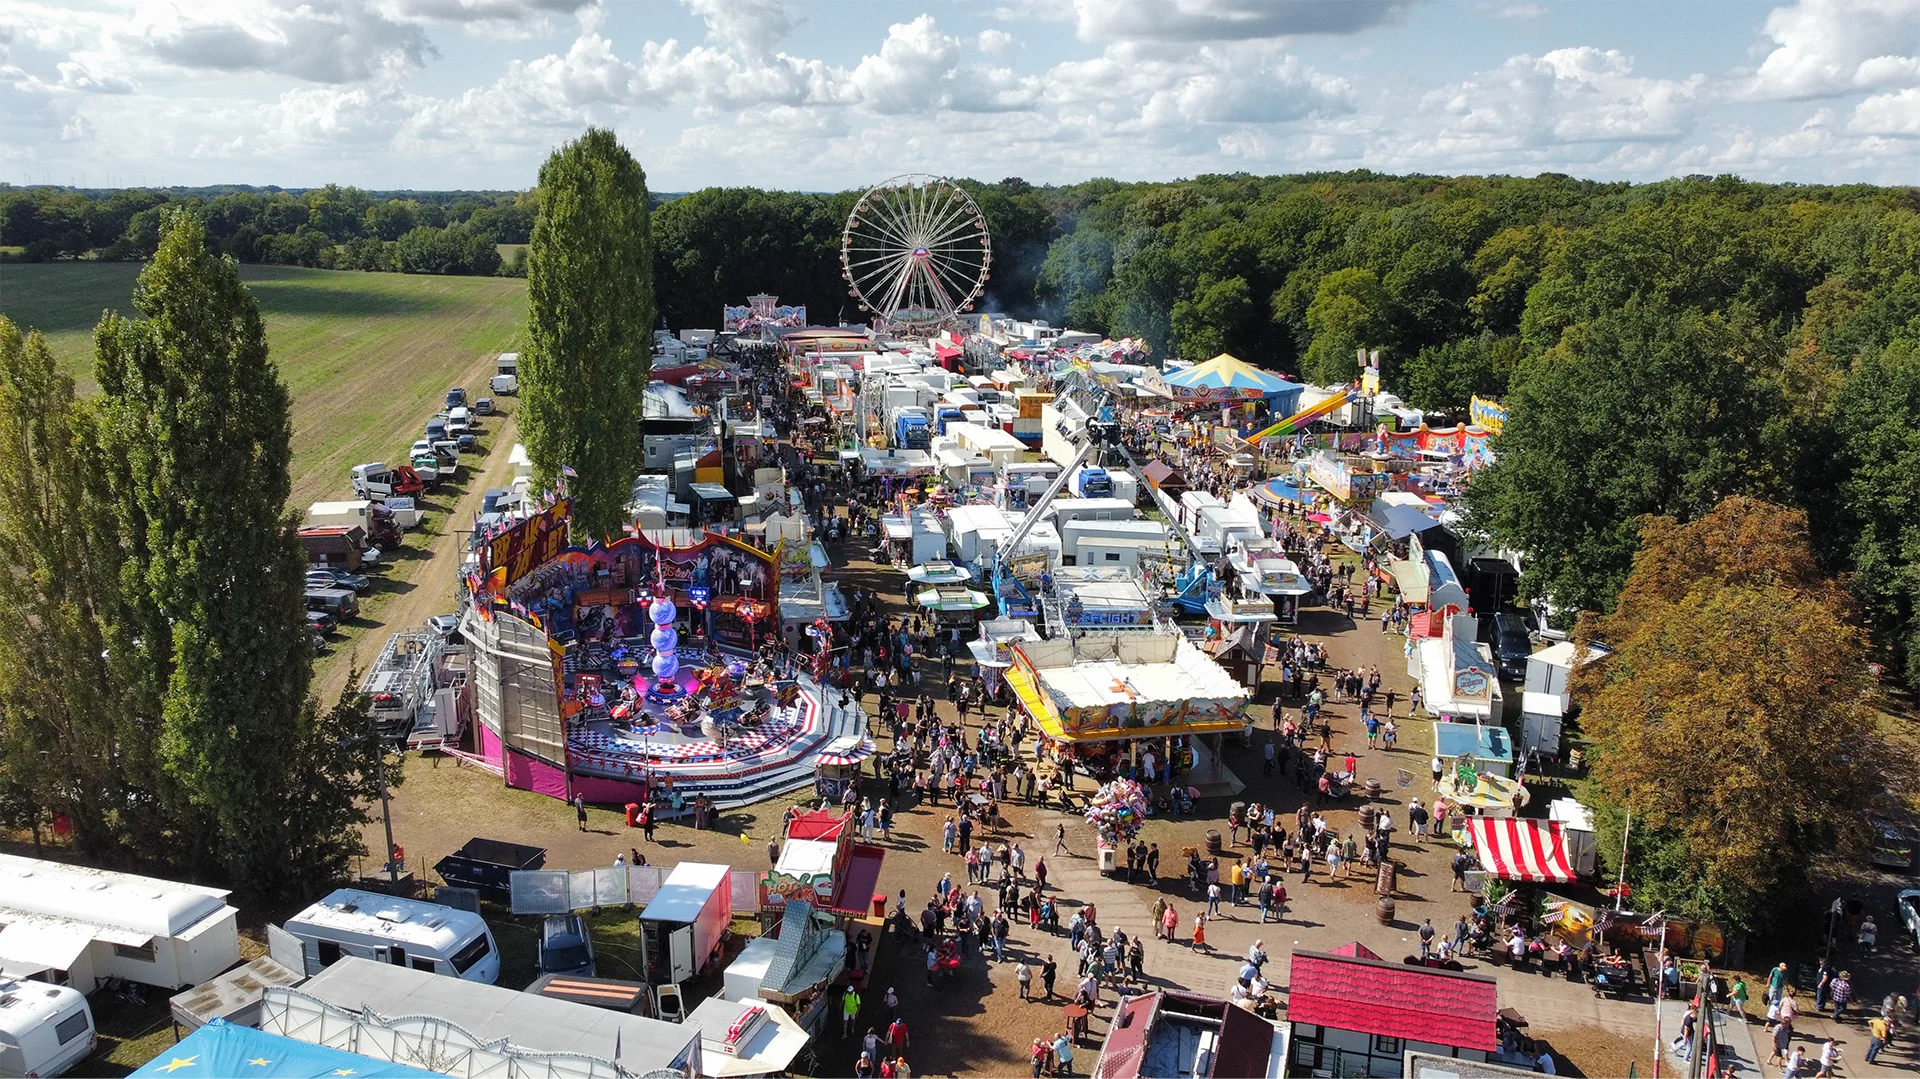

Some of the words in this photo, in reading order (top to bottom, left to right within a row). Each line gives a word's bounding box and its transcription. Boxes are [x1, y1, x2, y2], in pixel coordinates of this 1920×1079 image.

[491, 516, 542, 568] BRAK
[1091, 611, 1137, 624] FLIGHT
[768, 880, 798, 894] HOT
[762, 904, 785, 912] ASIAT
